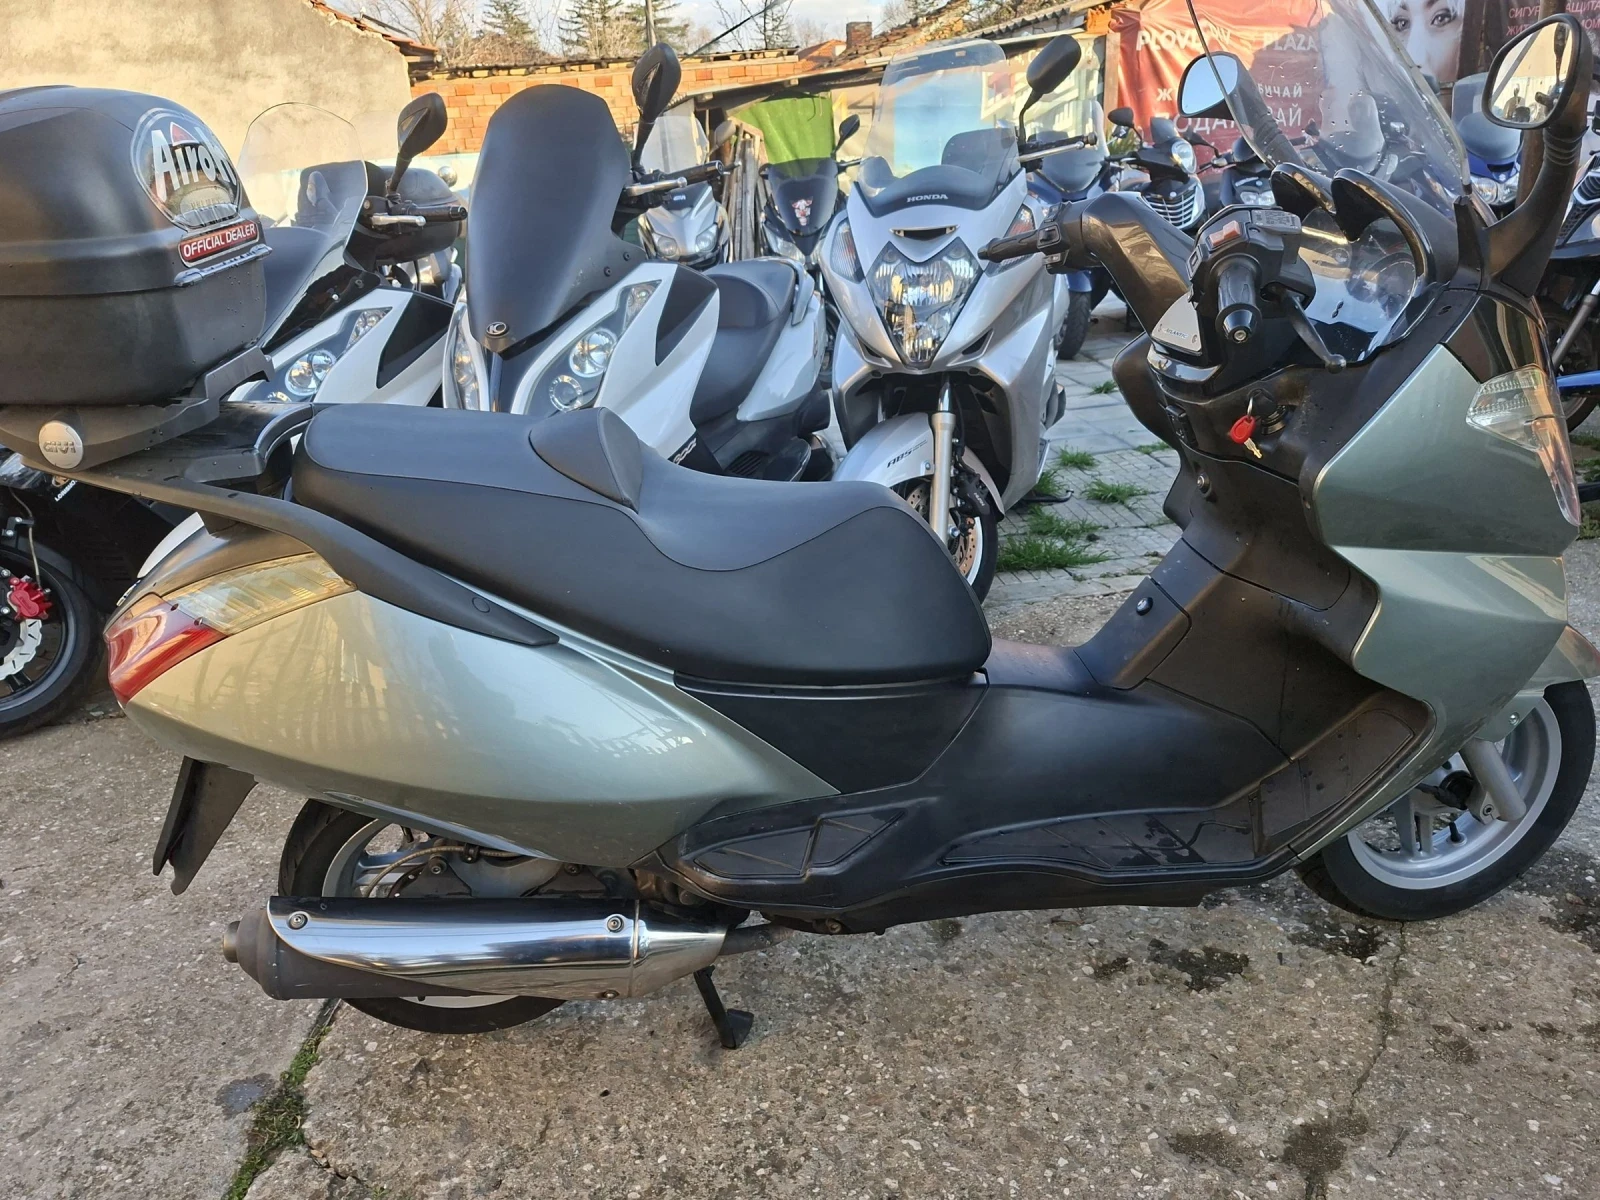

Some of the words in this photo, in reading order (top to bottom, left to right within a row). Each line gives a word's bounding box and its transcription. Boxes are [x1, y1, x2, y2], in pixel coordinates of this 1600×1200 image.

[1566, 1, 1600, 15] АЩИТА
[1263, 33, 1319, 52] PLAZA
[1257, 82, 1303, 98] БИЧАЙ
[906, 193, 949, 203] HONDA
[183, 233, 225, 258] OFFICIAL
[225, 223, 256, 244] DEALER
[886, 447, 912, 468] ABS
